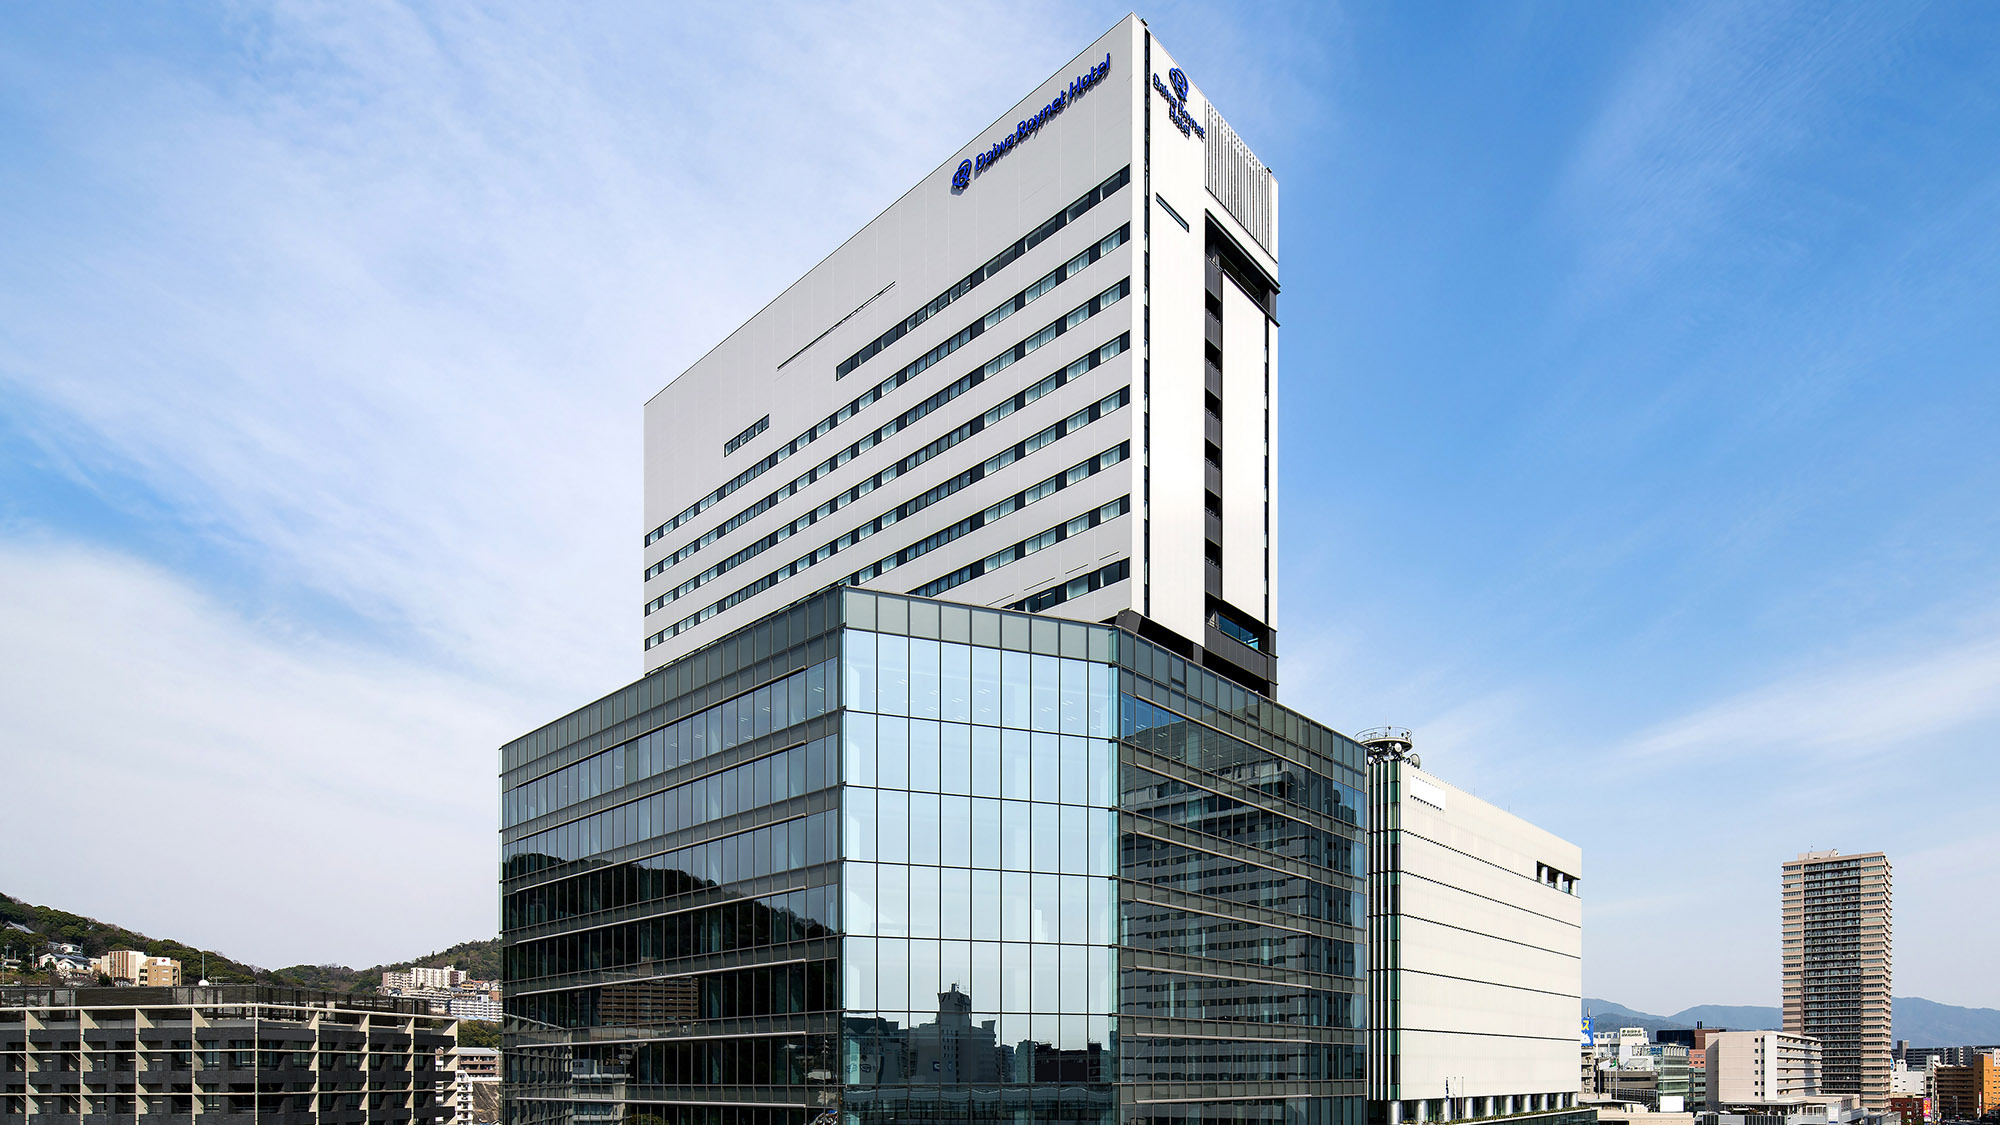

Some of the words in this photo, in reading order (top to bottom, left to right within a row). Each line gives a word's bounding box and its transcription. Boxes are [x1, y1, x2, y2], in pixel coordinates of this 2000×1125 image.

[975, 133, 1014, 171] Daiwa
[1016, 90, 1066, 139] Roynet
[1069, 52, 1110, 99] Hotel
[1153, 73, 1177, 108] Daiwa
[1178, 101, 1205, 139] Roynet
[1169, 105, 1190, 139] Hotel
